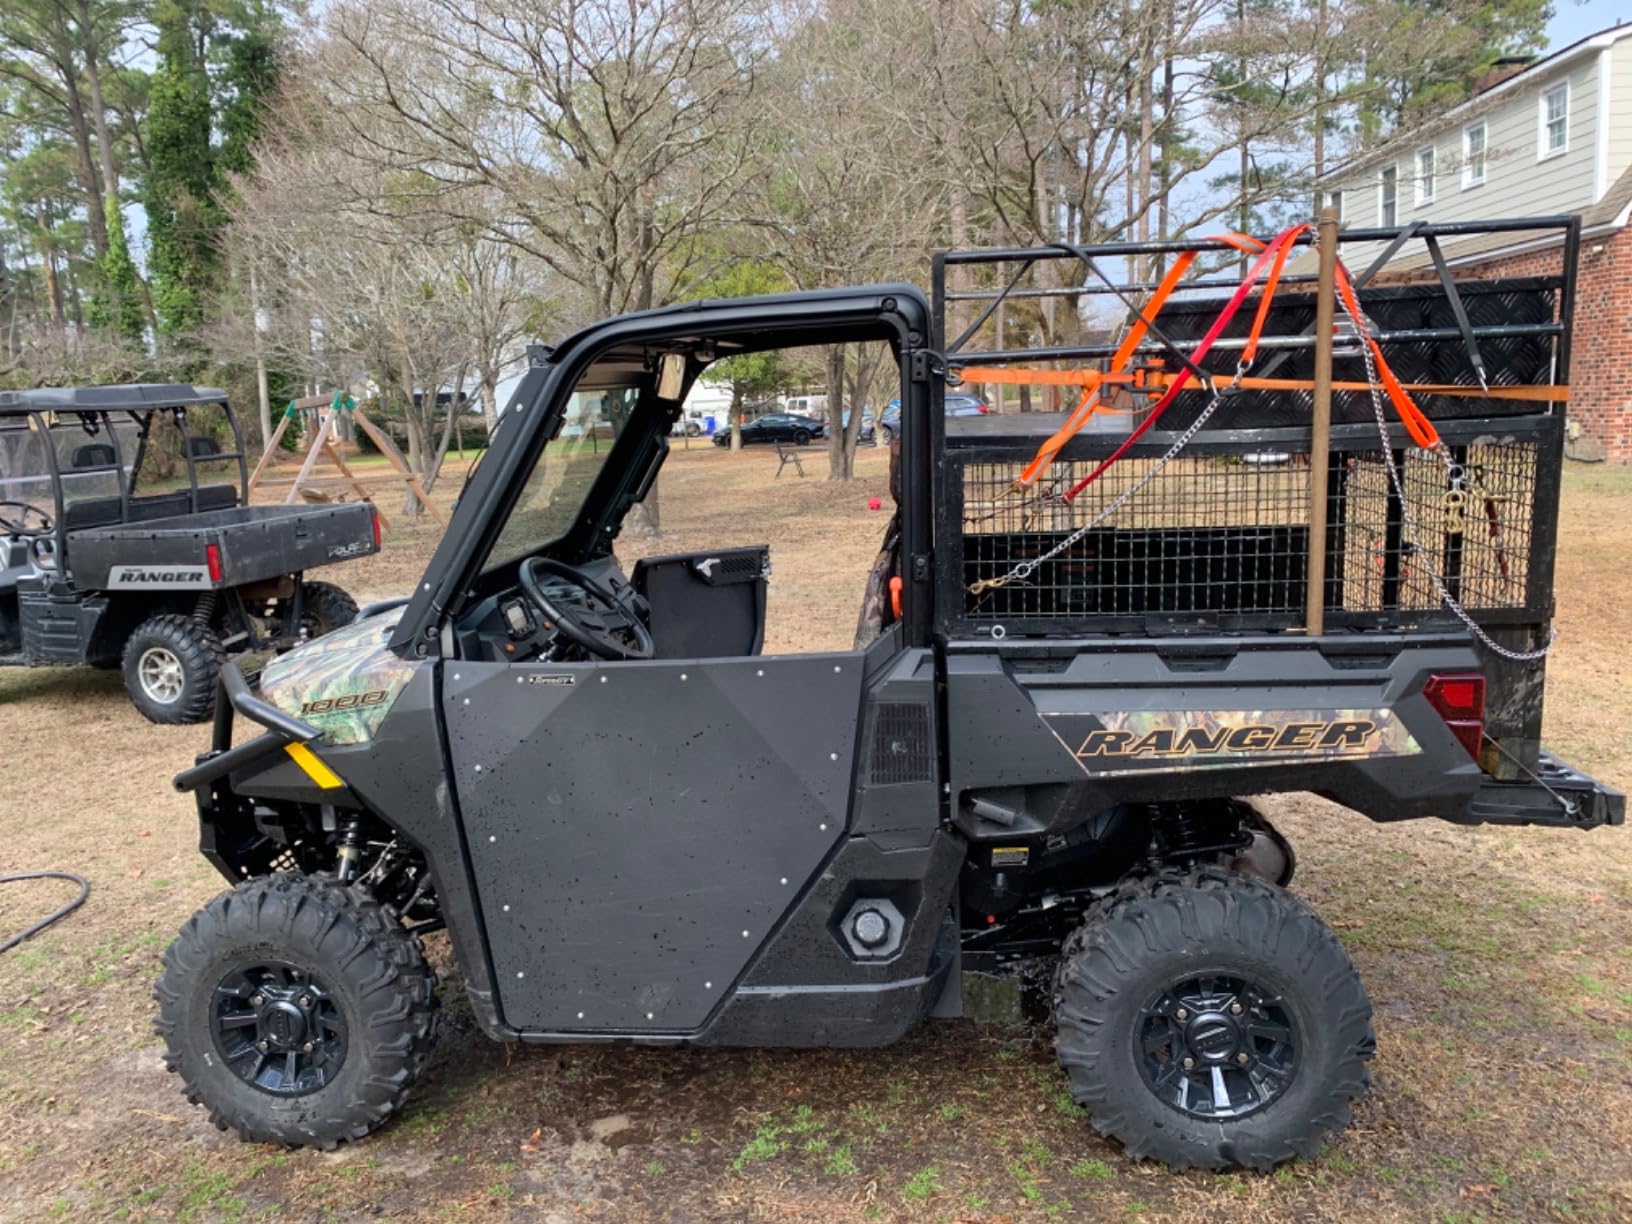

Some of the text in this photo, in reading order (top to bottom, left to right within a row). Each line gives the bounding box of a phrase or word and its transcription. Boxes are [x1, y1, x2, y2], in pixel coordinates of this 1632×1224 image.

[119, 571, 204, 583] RANGER
[302, 690, 388, 714] 1000
[1077, 721, 1377, 757] RANGER
